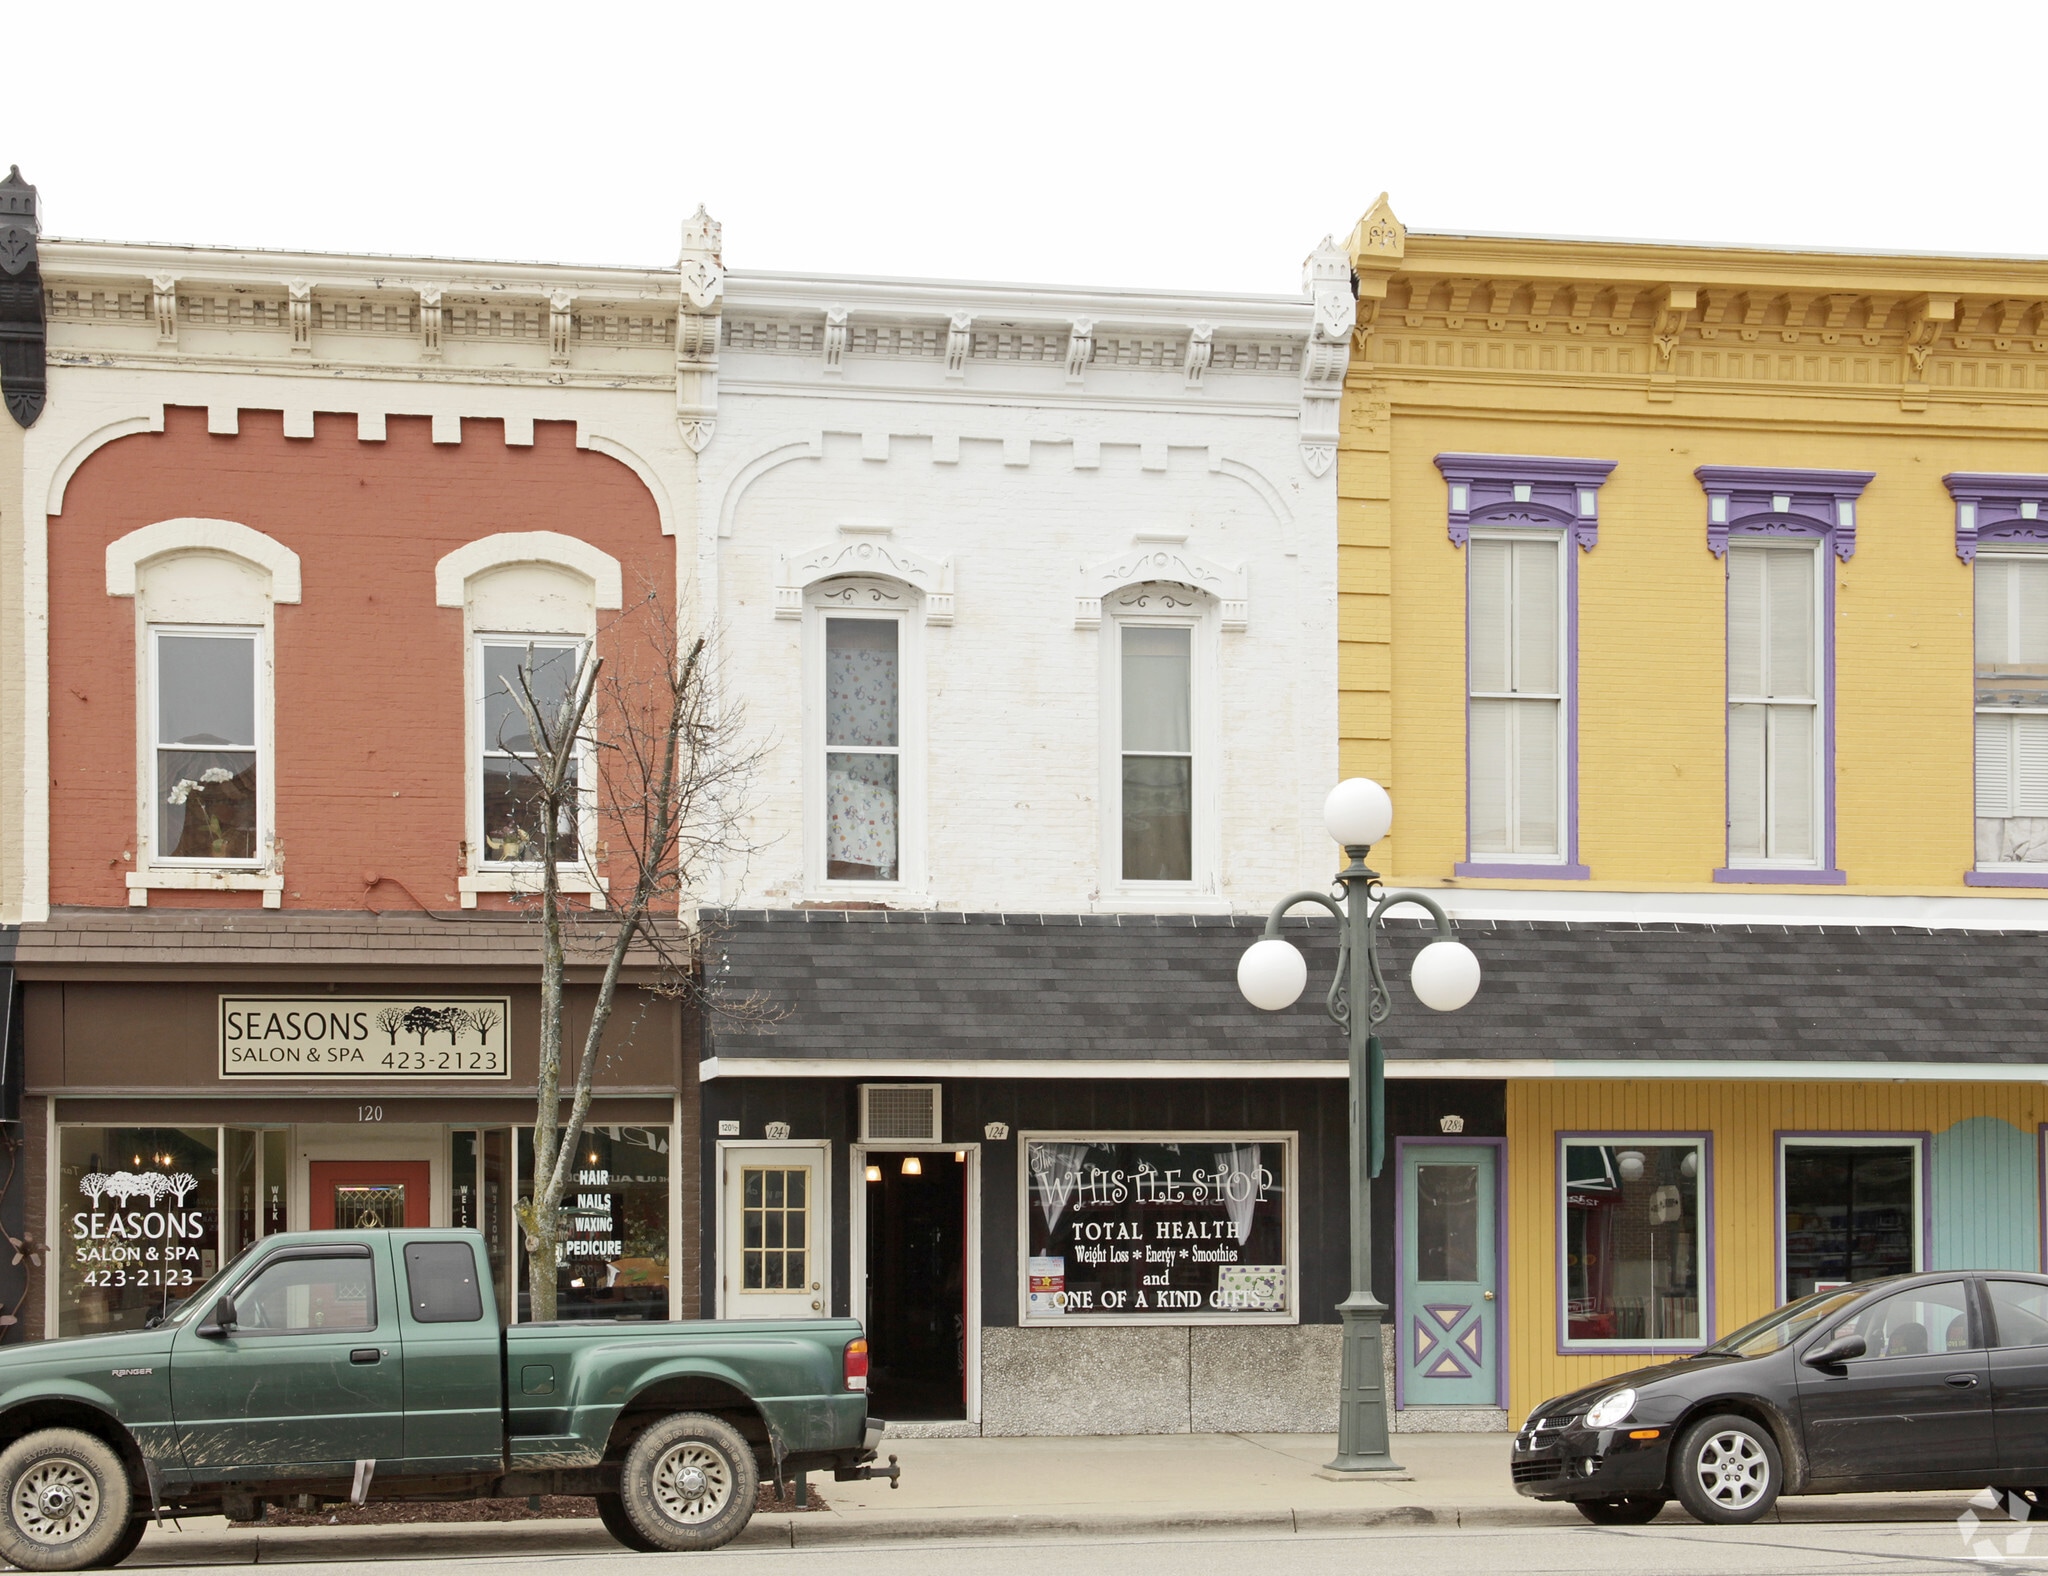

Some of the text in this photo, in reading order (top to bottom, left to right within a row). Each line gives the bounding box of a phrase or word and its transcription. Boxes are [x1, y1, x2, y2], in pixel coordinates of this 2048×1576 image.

[228, 1012, 368, 1040] SEASONS
[232, 1047, 364, 1062] SALON & SPA
[381, 1051, 497, 1070] 423-2123
[358, 1105, 383, 1121] 120
[989, 1126, 1004, 1138] 124
[1031, 1145, 1053, 1172] The
[579, 1170, 609, 1186] HAIR
[1037, 1163, 1273, 1211] WHISTLE STOP
[271, 1185, 279, 1220] WALK
[578, 1193, 611, 1210] NAILS
[73, 1212, 204, 1239] SEASONS
[575, 1217, 613, 1232] WAXING
[1072, 1221, 1240, 1241] TOTAL HEALTH
[77, 1246, 199, 1261] SALON & SPA
[567, 1240, 622, 1255] PEDICURE
[1075, 1244, 1107, 1267] Weight
[1110, 1245, 1129, 1262] Loss
[1146, 1244, 1176, 1267] Energy
[1192, 1243, 1238, 1262] Smoothies
[84, 1269, 193, 1287] 423-2123
[1143, 1270, 1170, 1286] and
[1053, 1290, 1261, 1308] ONE OF A KIND GIFTS
[112, 1368, 152, 1378] RANGER
[650, 1428, 704, 1460] COOPER
